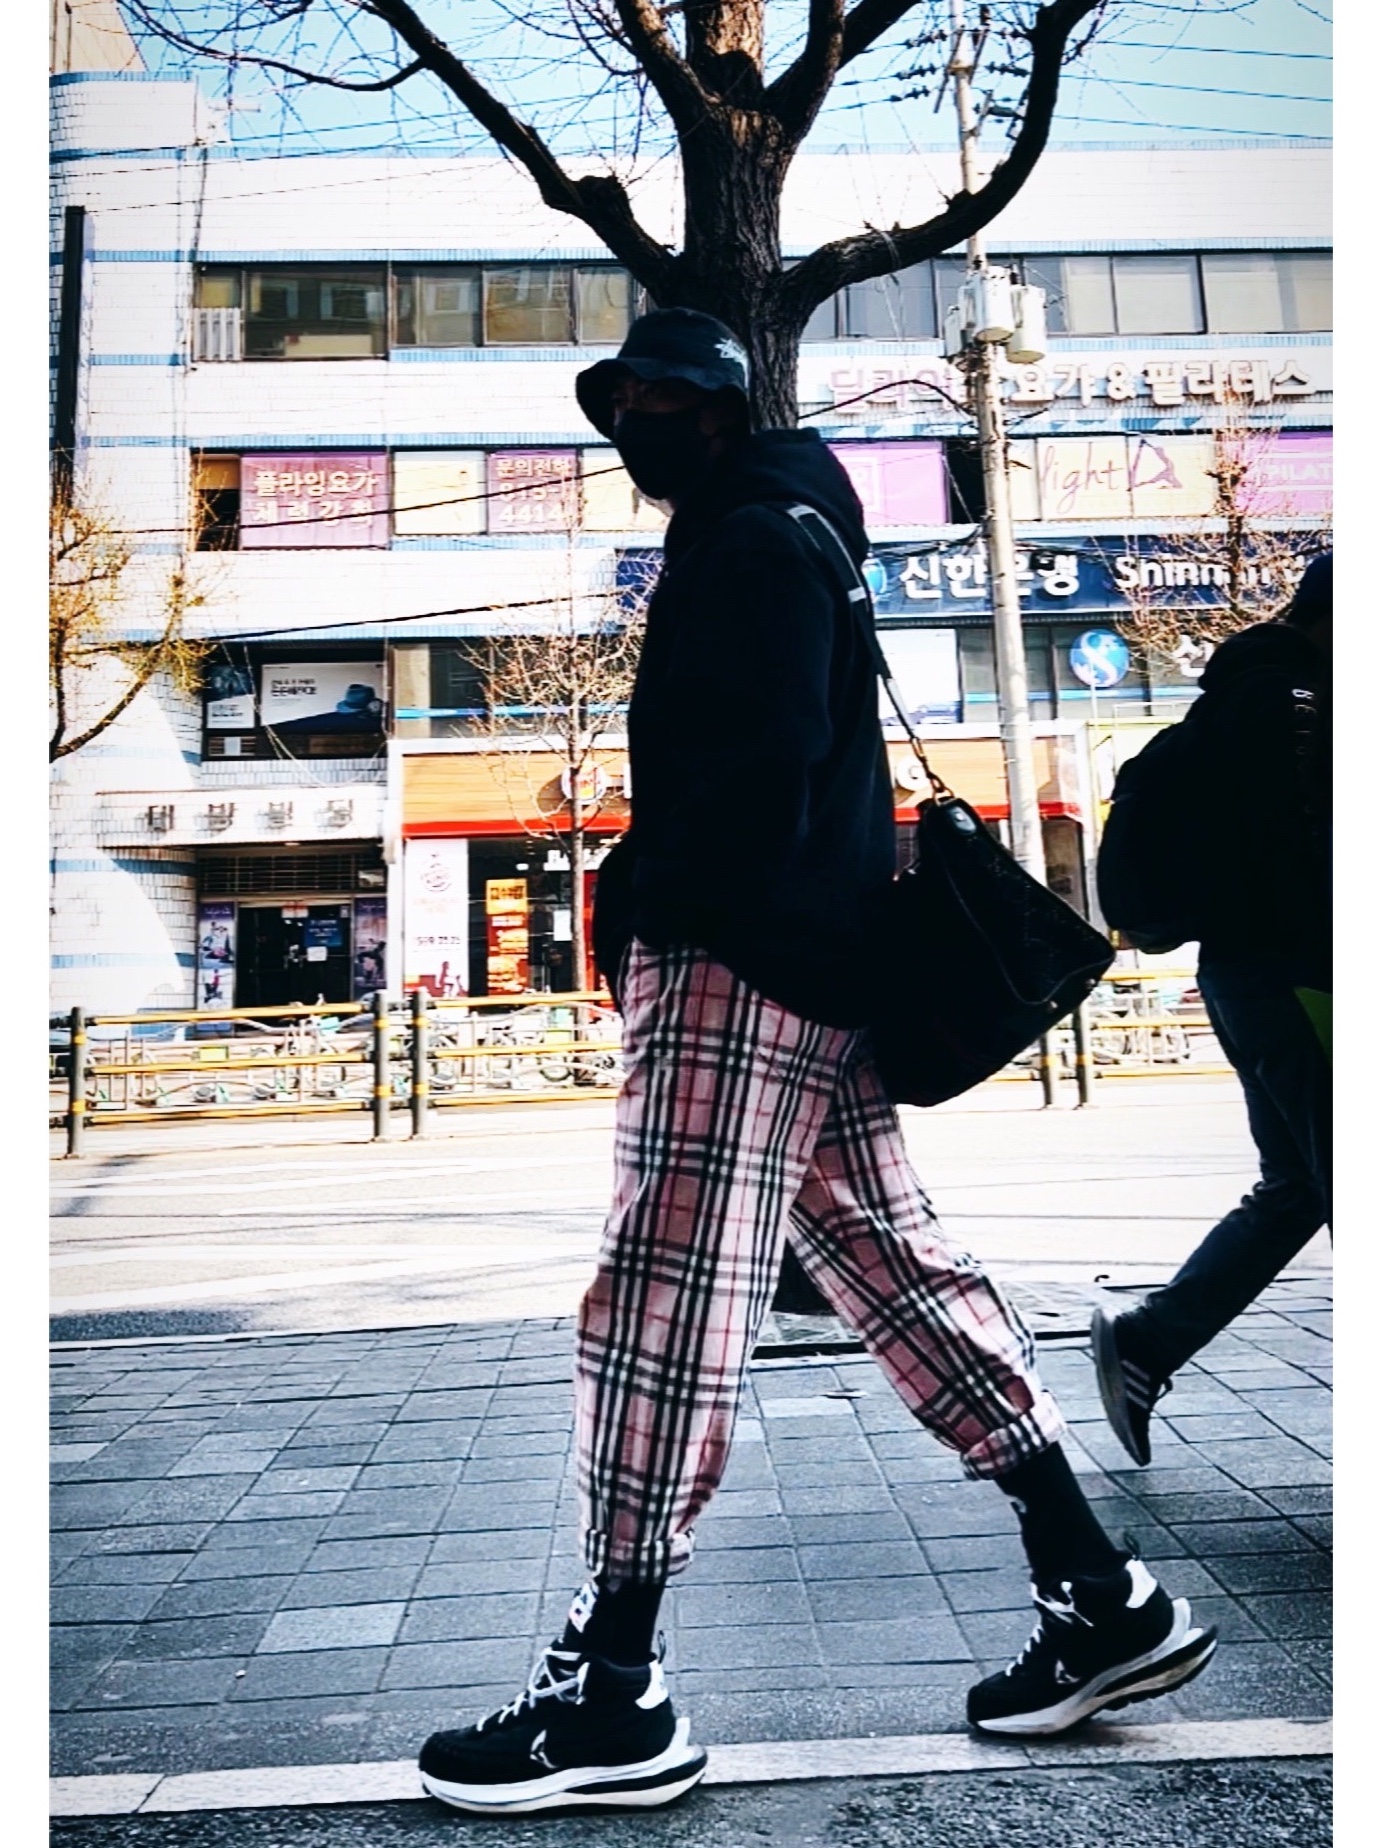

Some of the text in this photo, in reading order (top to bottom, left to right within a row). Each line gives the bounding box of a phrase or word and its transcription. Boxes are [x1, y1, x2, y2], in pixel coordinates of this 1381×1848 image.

[831, 360, 1317, 413] 딜라이 요가 & 필라테스
[254, 470, 380, 498] 플라잉요가
